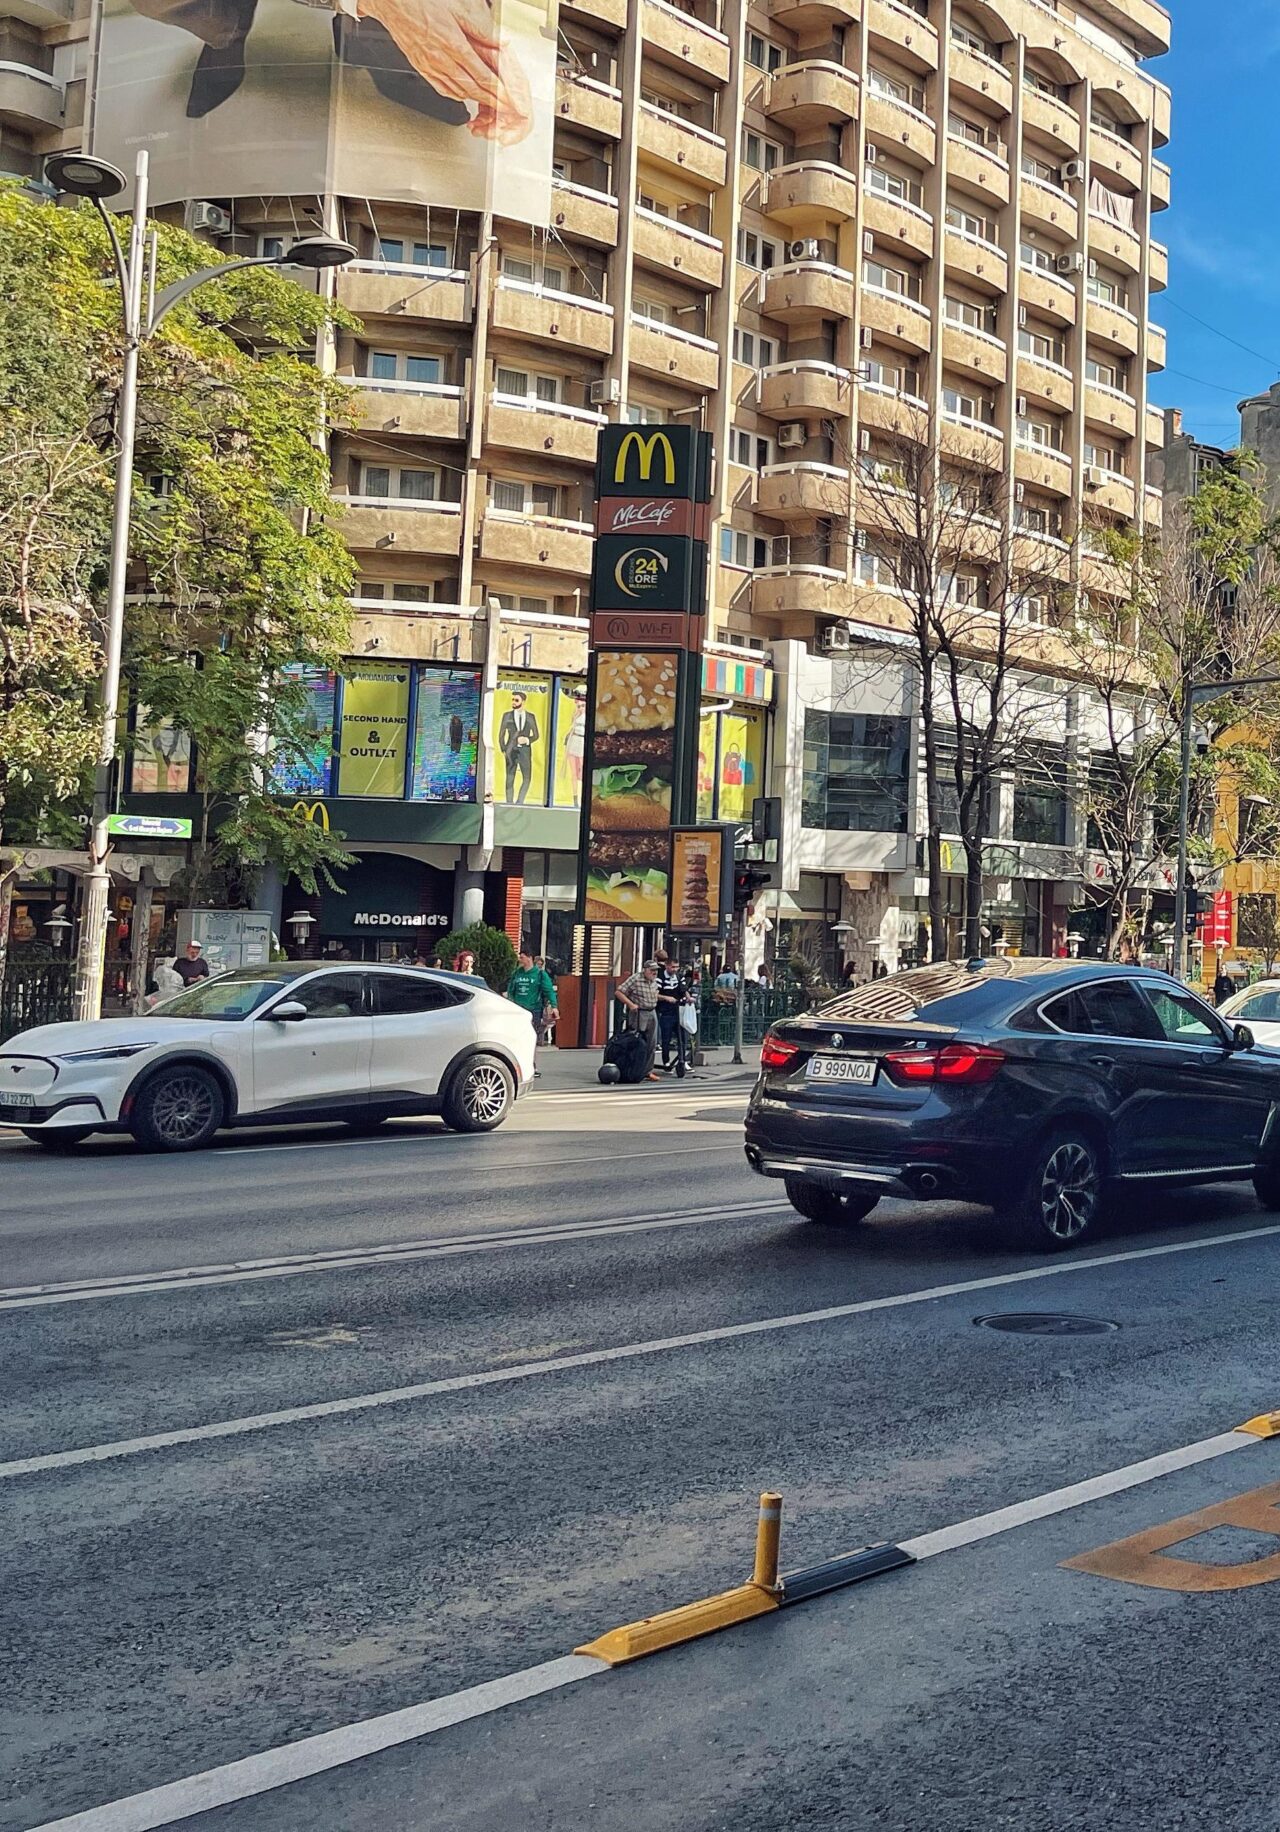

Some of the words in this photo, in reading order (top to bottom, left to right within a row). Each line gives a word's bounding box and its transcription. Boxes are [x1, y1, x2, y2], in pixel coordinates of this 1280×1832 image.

[635, 558, 658, 574] 24
[634, 575, 658, 584] ORE
[639, 623, 672, 634] Wi-Fi
[343, 715, 379, 723] SECOND
[368, 731, 380, 743] &
[350, 748, 397, 758] OUTLET
[354, 913, 448, 925] McDonald's
[812, 1060, 821, 1075] B
